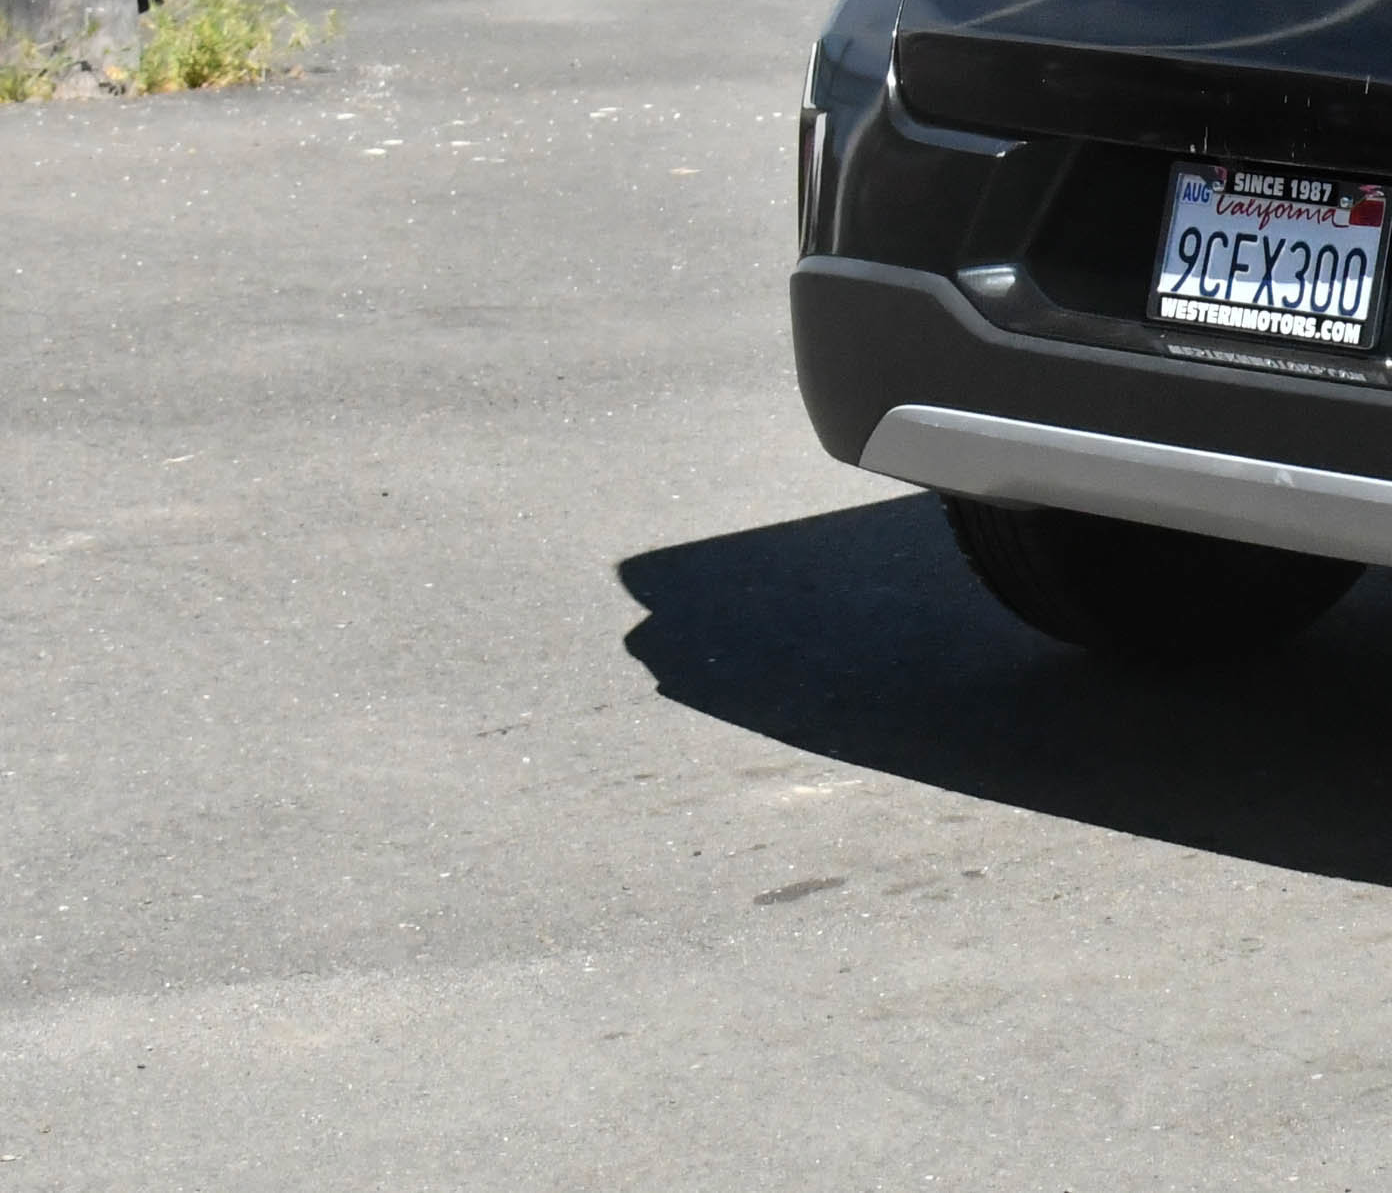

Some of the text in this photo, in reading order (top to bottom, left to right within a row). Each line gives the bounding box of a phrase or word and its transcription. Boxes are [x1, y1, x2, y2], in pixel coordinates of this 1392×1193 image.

[1183, 181, 1210, 203] AUG
[1234, 173, 1333, 202] SINCE 1987
[1216, 195, 1349, 230] California
[1171, 227, 1367, 316] 9CFX300
[1160, 297, 1361, 344] WESTERNMOTORS.COM
